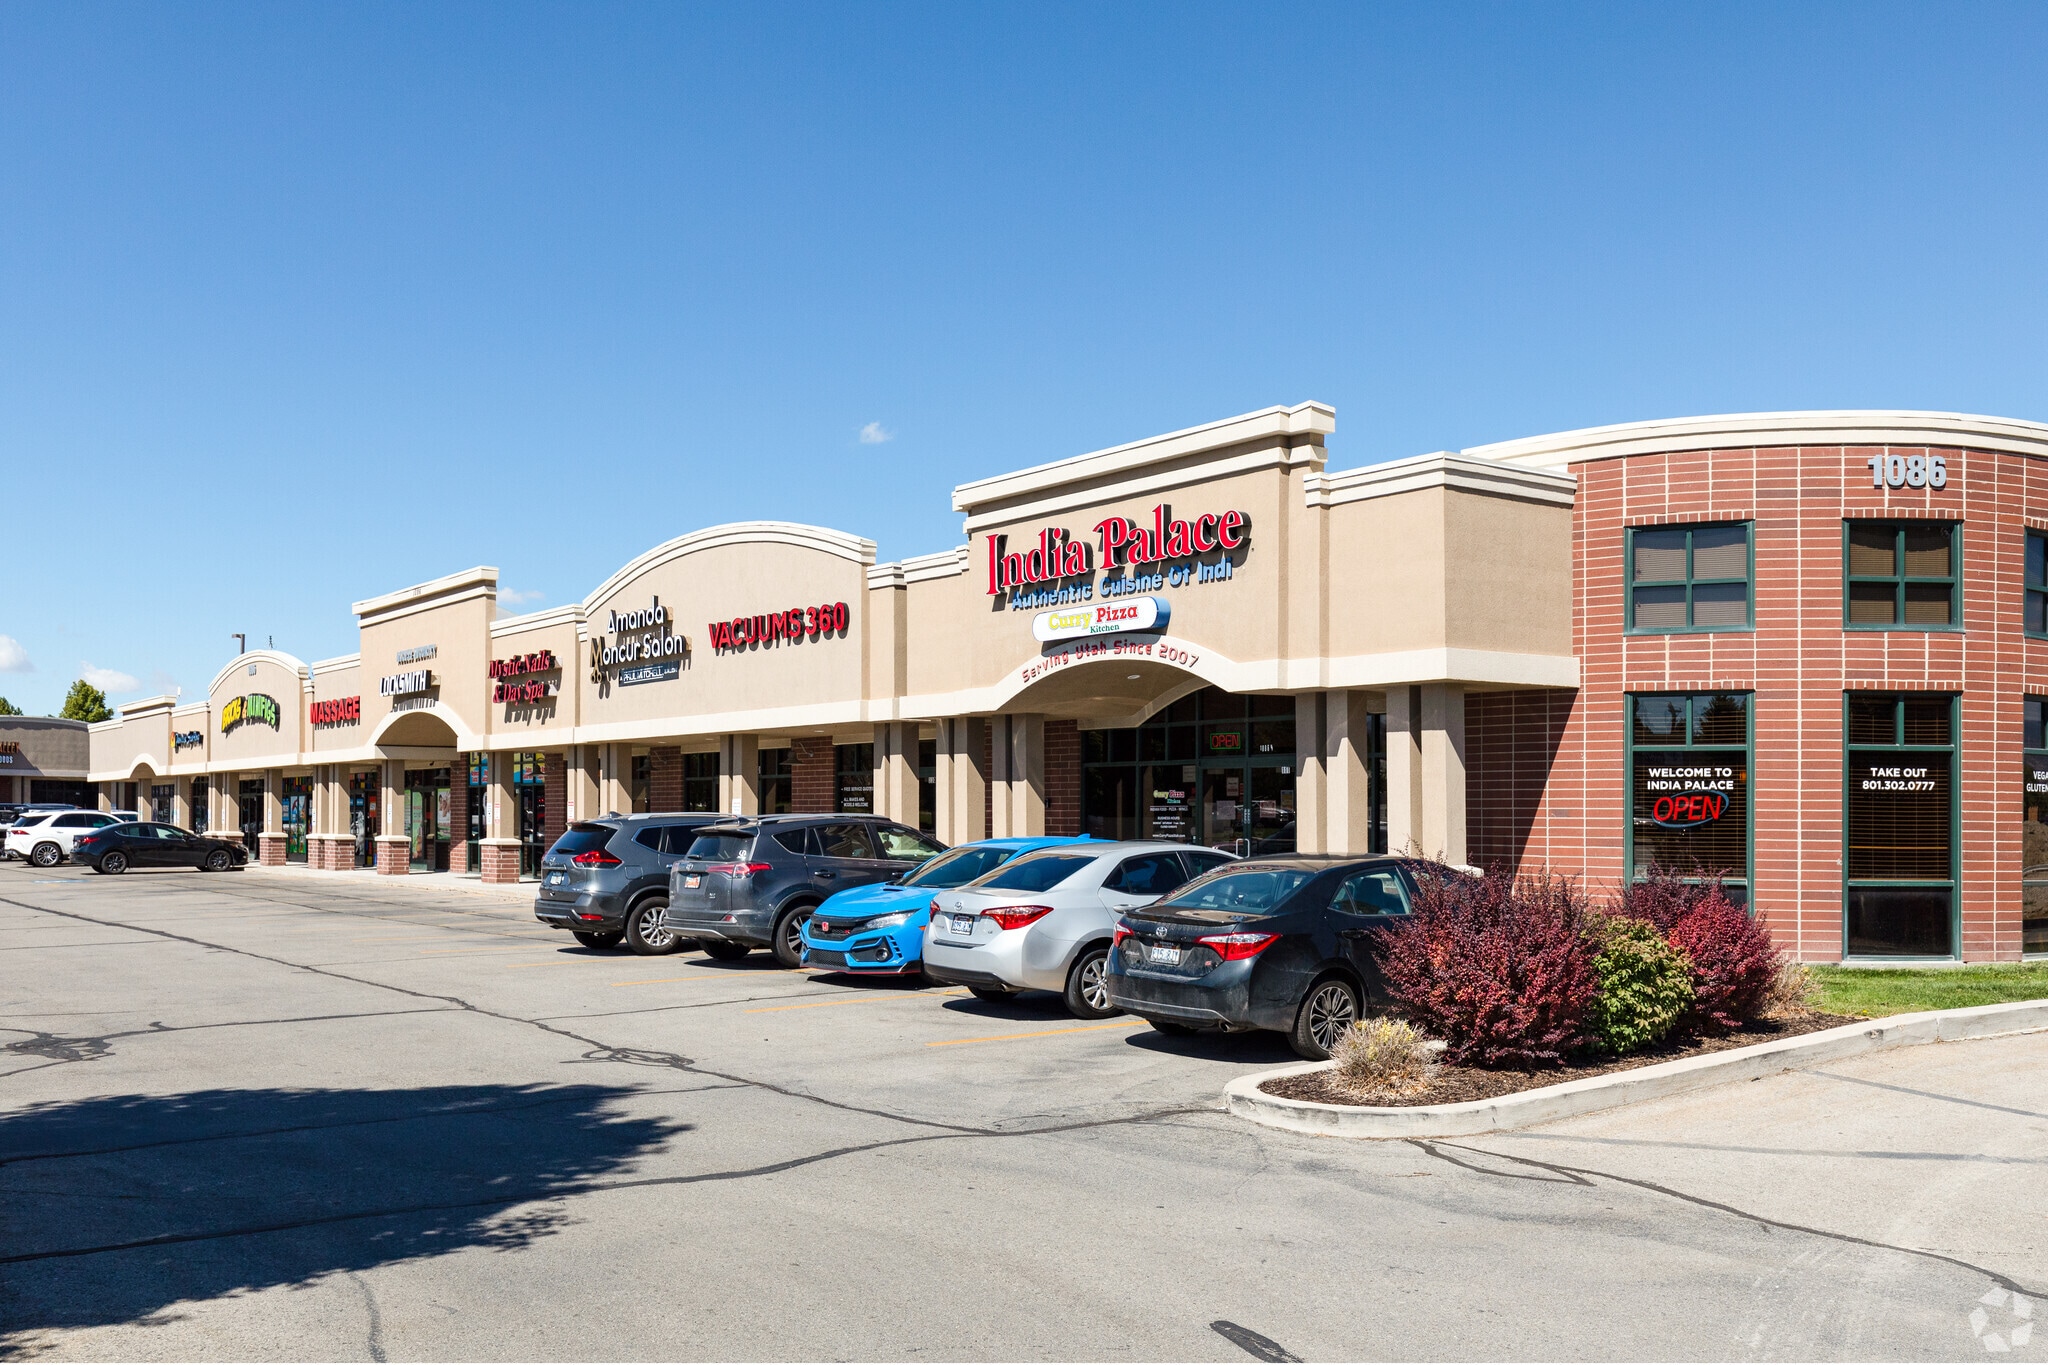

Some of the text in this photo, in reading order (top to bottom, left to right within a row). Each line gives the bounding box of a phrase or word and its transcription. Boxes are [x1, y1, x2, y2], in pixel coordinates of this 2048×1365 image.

[1867, 454, 1947, 489] 1086
[986, 503, 1245, 597] India Palace
[1012, 557, 1233, 610] Authentic Cuisine Of Indi
[607, 595, 664, 633] Amanda
[708, 601, 846, 649] VACUUMS 360
[1048, 604, 1139, 630] Curry Pizza
[1090, 623, 1120, 634] Kitchen
[590, 626, 683, 668] Moncur Salon
[1022, 639, 1200, 683] Serving Utah Since 2007
[488, 650, 550, 682] Mystic Nails
[379, 669, 427, 697] LOCKSMITH
[492, 680, 545, 706] & Day Spa
[310, 696, 360, 724] MASSAGE
[1212, 734, 1239, 748] OPEN
[1647, 780, 1734, 790] INDIA PALACE
[1648, 767, 1732, 778] WELCOME TO
[1862, 780, 1935, 790] 801.302.0777
[1870, 767, 1927, 778] TAKE OUT
[1653, 795, 1722, 822] OPEN
